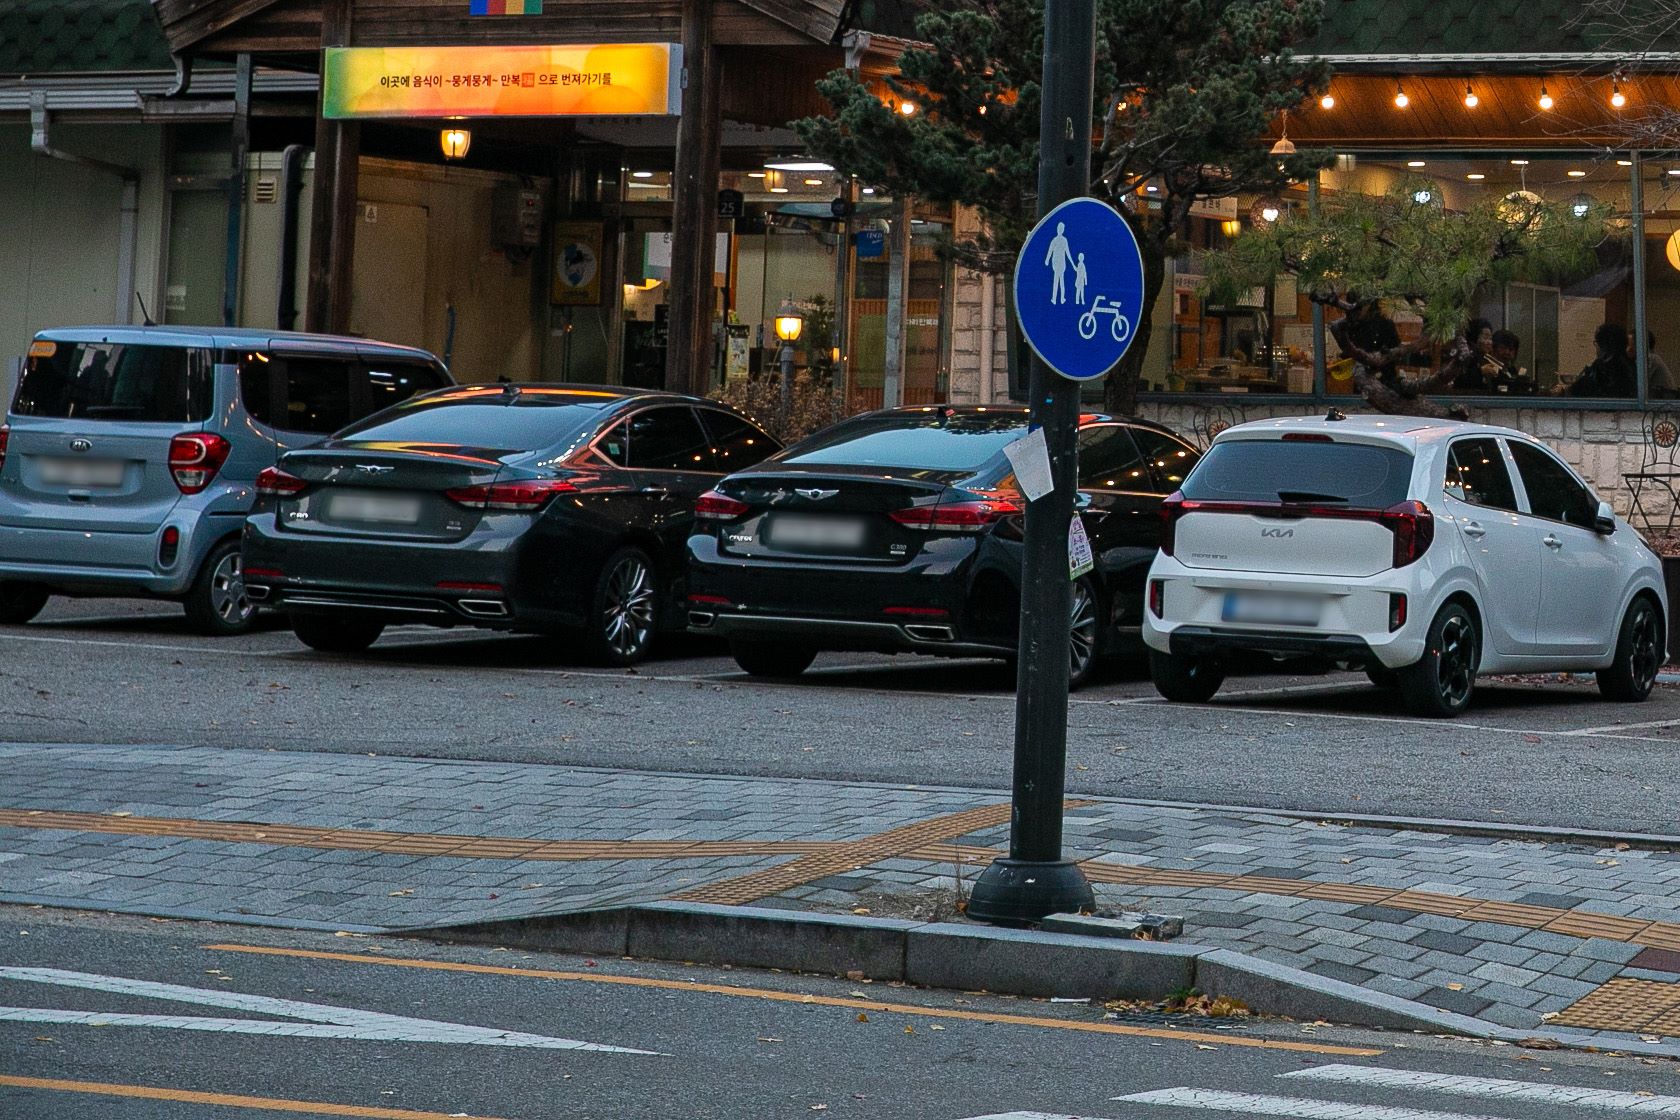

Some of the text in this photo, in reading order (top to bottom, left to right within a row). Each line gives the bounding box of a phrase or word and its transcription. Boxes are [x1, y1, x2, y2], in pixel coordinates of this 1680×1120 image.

[380, 75, 411, 89] 이곳에
[413, 75, 443, 88] 음식이
[538, 73, 559, 86] 으로
[561, 72, 612, 86] 번져가기를
[720, 202, 735, 214] 25
[1261, 528, 1294, 538] KIA
